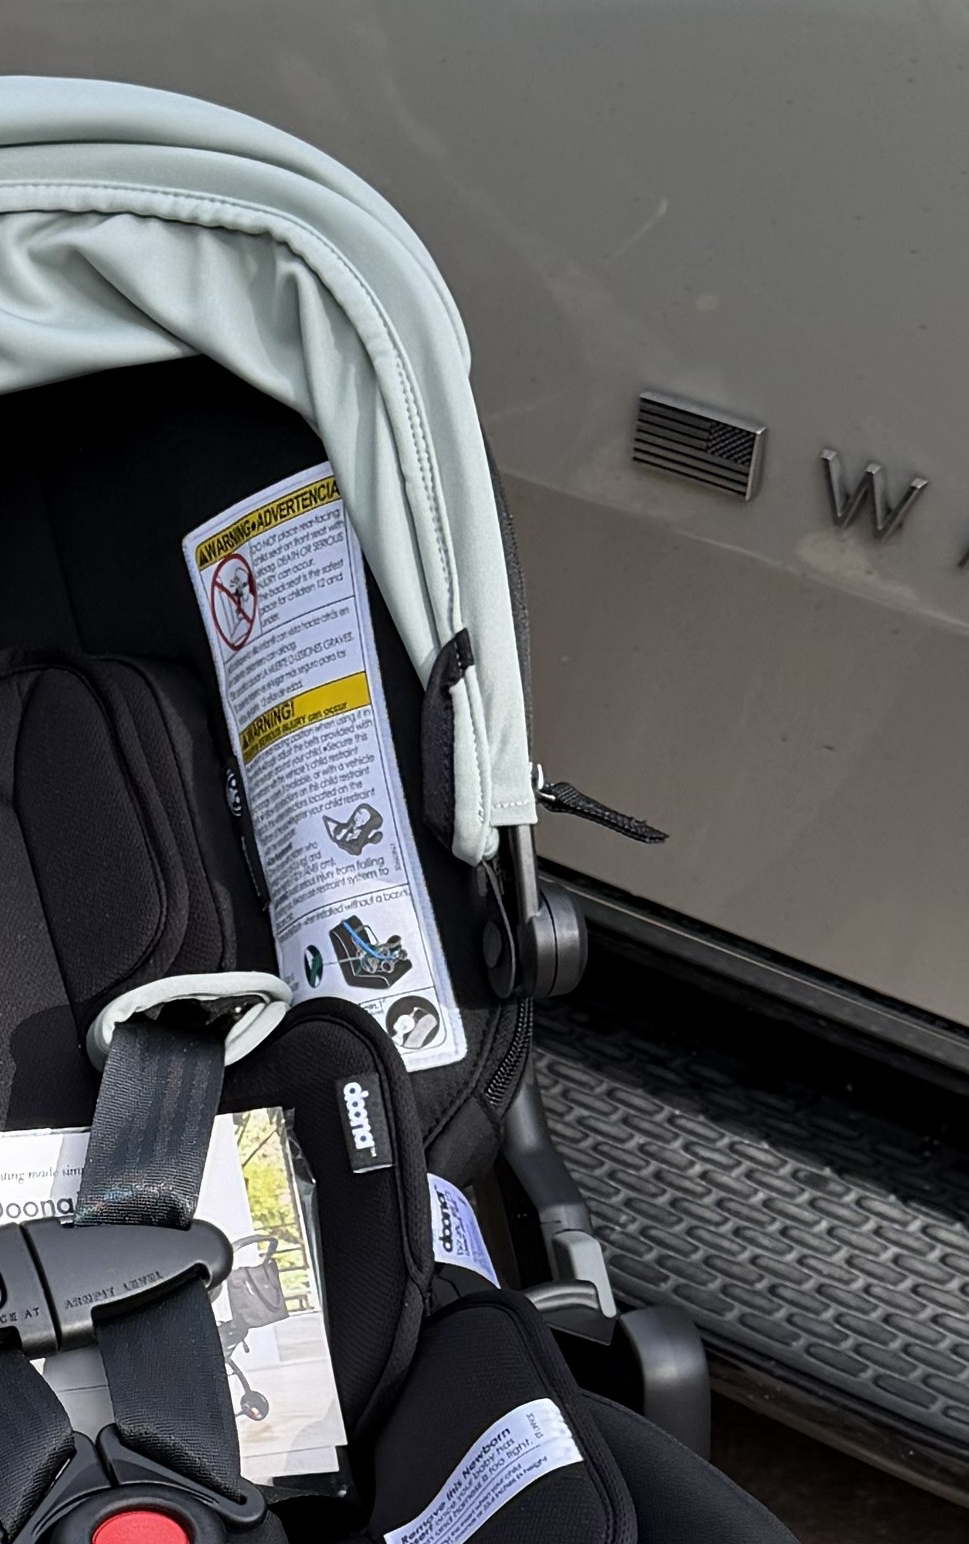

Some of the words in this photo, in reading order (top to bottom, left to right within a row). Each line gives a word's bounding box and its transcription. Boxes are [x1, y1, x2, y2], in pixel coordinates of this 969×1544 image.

[326, 572, 343, 586] and
[343, 1082, 375, 1150] doona
[24, 1307, 41, 1318] AT
[123, 1271, 163, 1291] LEVEL
[446, 1480, 462, 1501] this
[462, 1428, 511, 1480] Newborn
[496, 1438, 515, 1455] has
[435, 1515, 454, 1537] and
[488, 1457, 505, 1474] too
